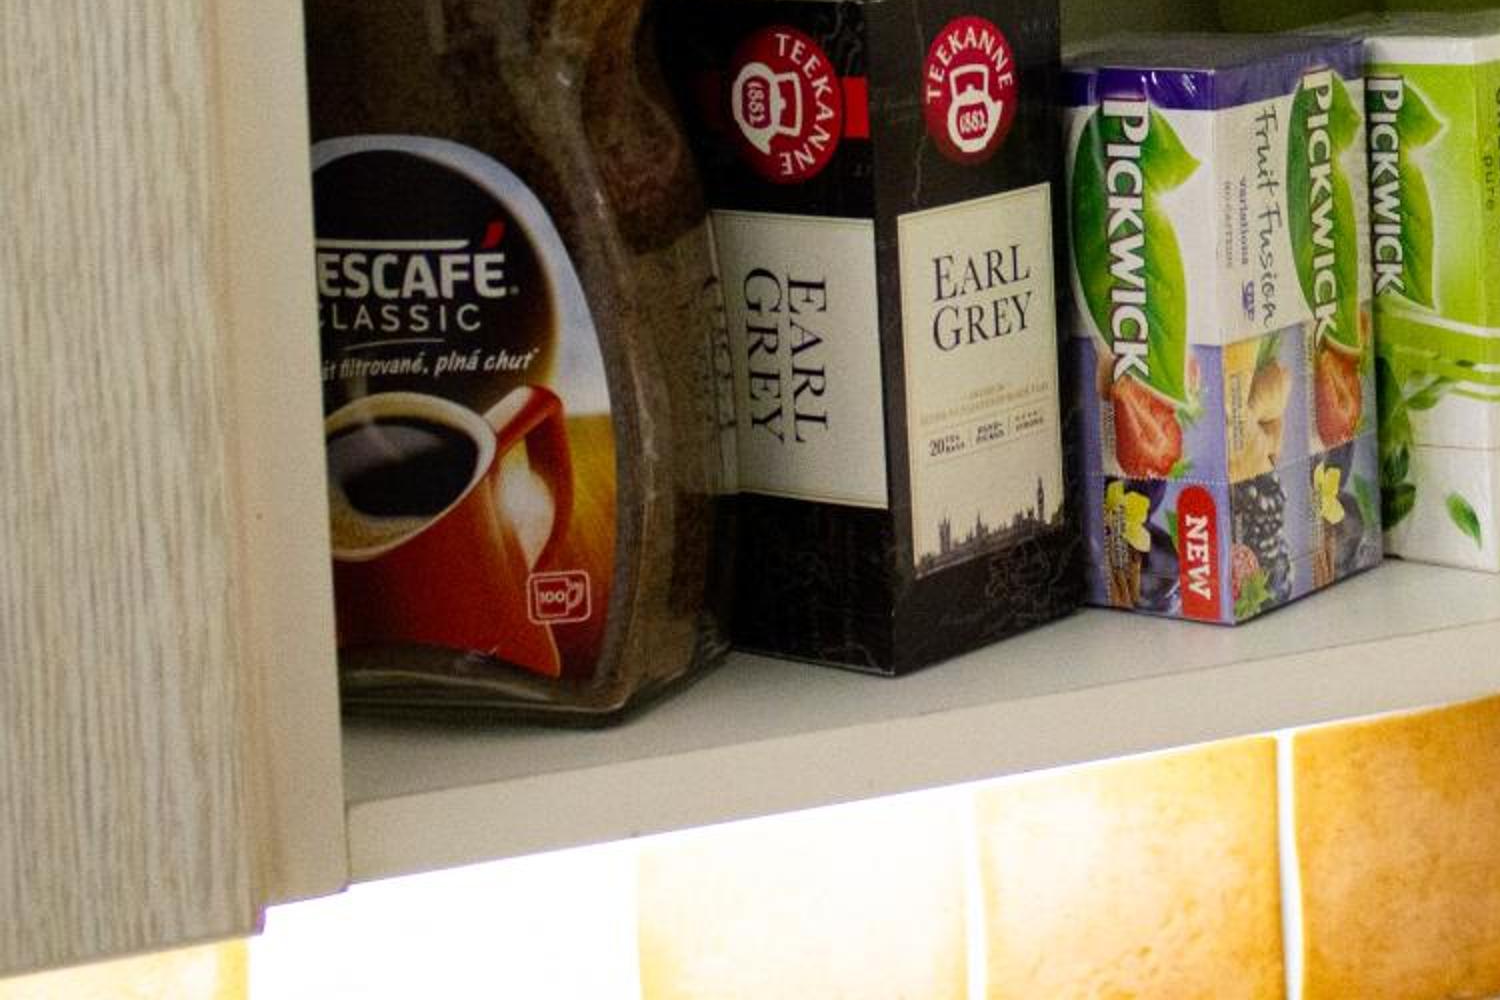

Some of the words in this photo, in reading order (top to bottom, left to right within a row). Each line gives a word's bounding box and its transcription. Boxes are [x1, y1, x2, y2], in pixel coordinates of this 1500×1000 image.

[774, 32, 835, 176] TEEKANNE
[927, 26, 1013, 104] TEEKANNE
[1255, 104, 1279, 191] Fruit
[1303, 65, 1337, 349] PICKWICK
[1367, 75, 1404, 296] PICKWICK
[317, 220, 506, 300] ESCAFÉ
[932, 244, 1031, 302] EARL
[1103, 97, 1149, 384] PICKWICK
[1258, 207, 1283, 329] Fusion
[743, 267, 785, 446] GREY
[787, 273, 829, 443] EARL
[933, 291, 1032, 352] GREY
[1184, 513, 1212, 601] NEW
